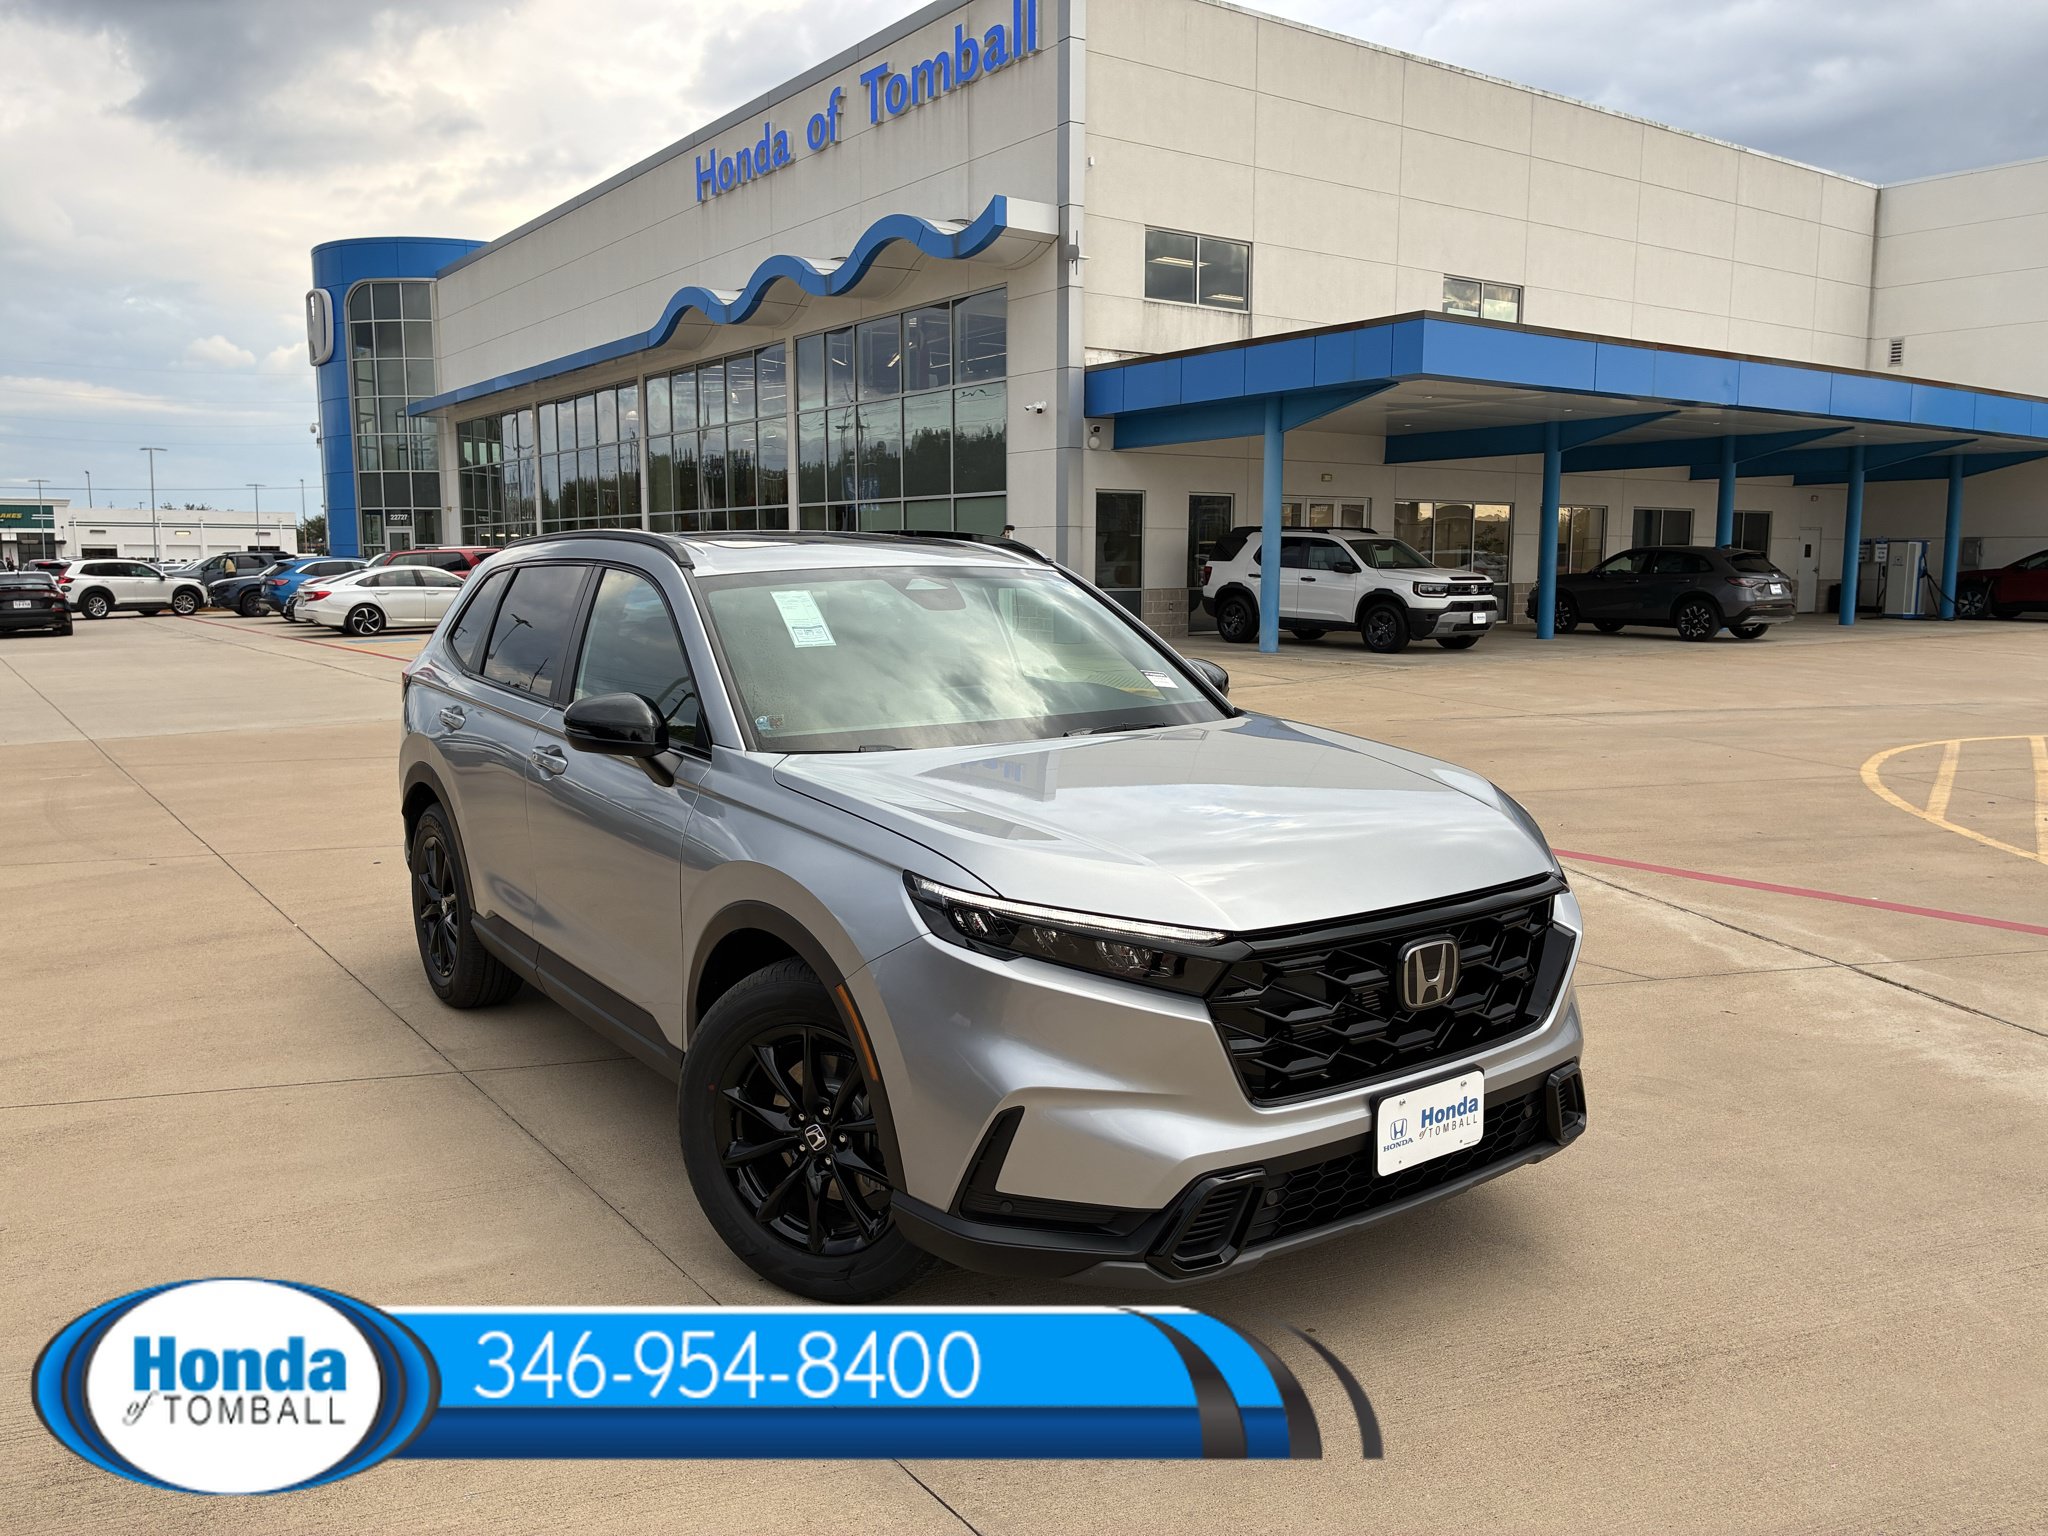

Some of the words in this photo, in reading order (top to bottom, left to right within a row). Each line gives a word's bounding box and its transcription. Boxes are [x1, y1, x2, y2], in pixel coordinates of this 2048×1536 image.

[695, 121, 791, 202] Honda
[806, 86, 843, 151] of
[860, 0, 1039, 125] Tomball
[1419, 1126, 1428, 1140] of
[1429, 1114, 1478, 1138] TOMBALL
[1420, 1095, 1479, 1129] Honda
[1383, 1137, 1414, 1153] HONDA
